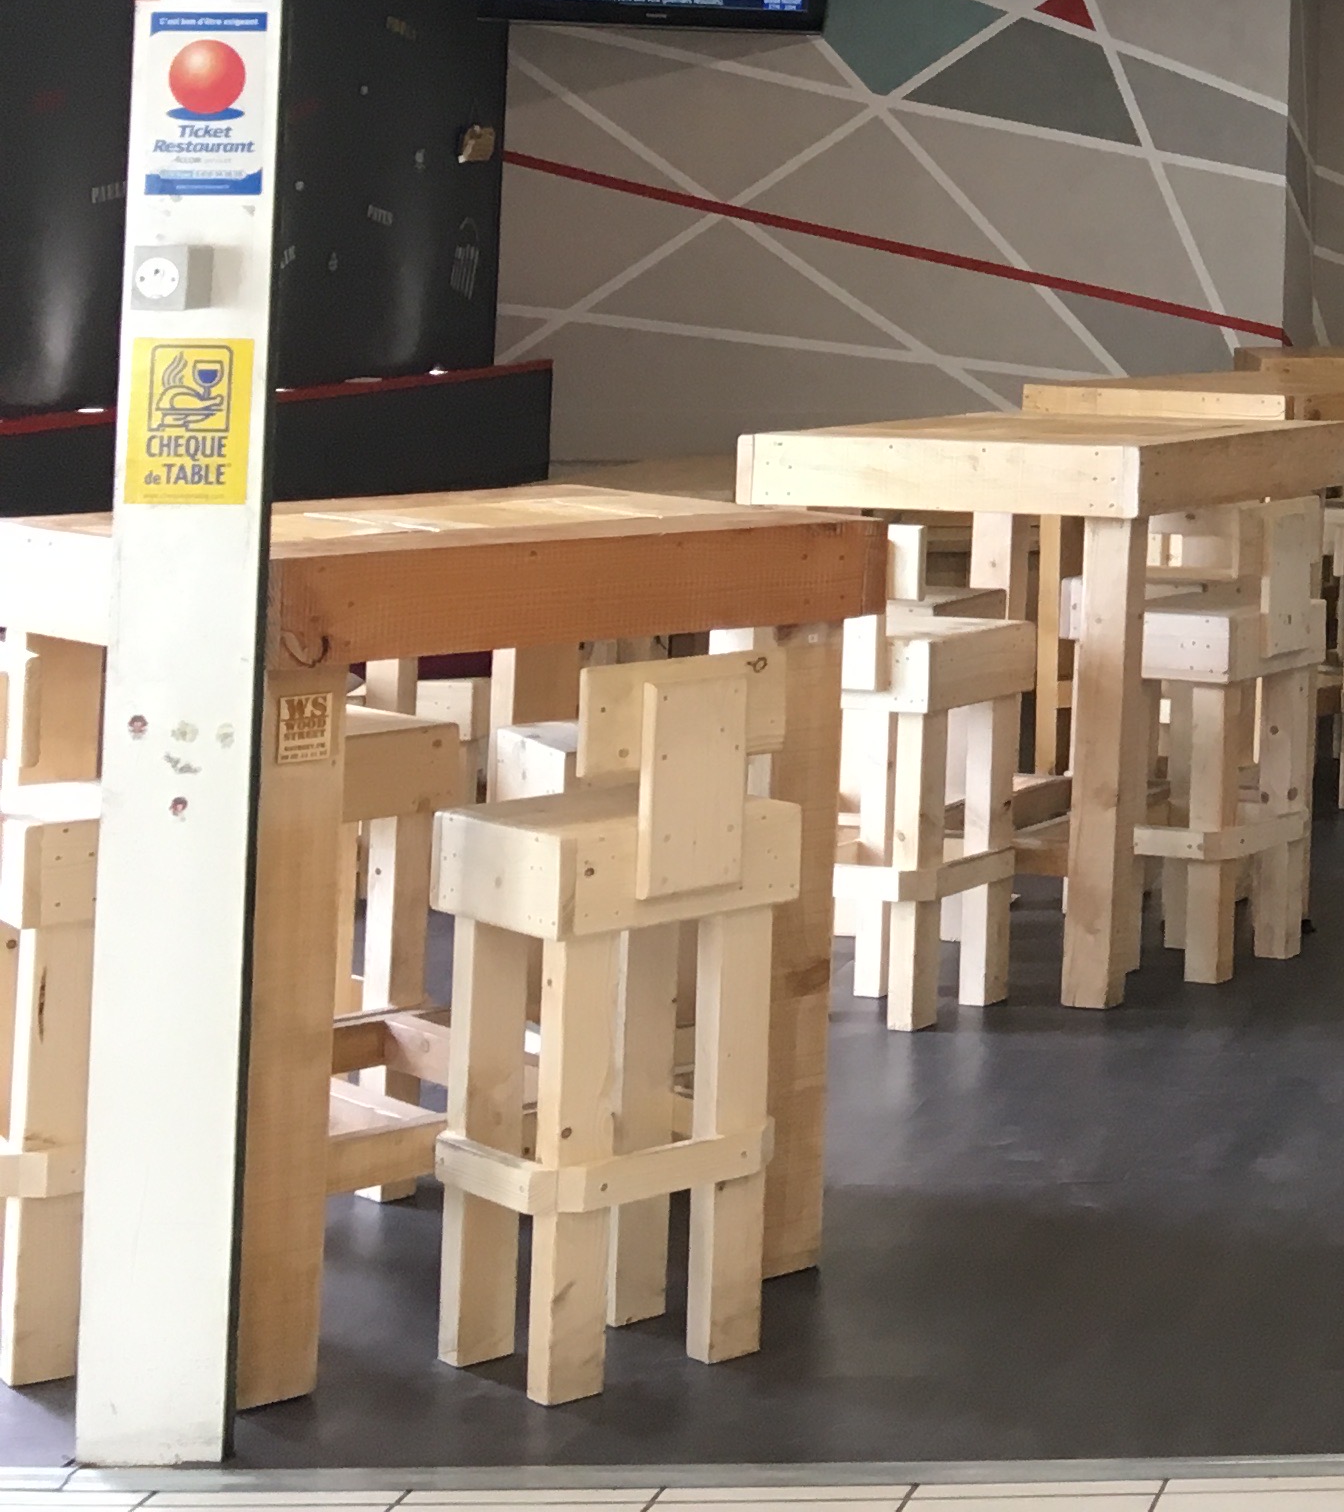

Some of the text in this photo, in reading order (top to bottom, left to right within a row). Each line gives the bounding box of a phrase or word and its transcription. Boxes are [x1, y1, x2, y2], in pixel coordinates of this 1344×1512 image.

[178, 125, 232, 138] Ticket
[153, 139, 255, 153] Restaurant
[145, 435, 227, 462] CHEQUE
[144, 463, 227, 485] de TABLE
[285, 696, 328, 719] WS
[284, 718, 327, 731] WOOD
[284, 729, 326, 742] STREET
